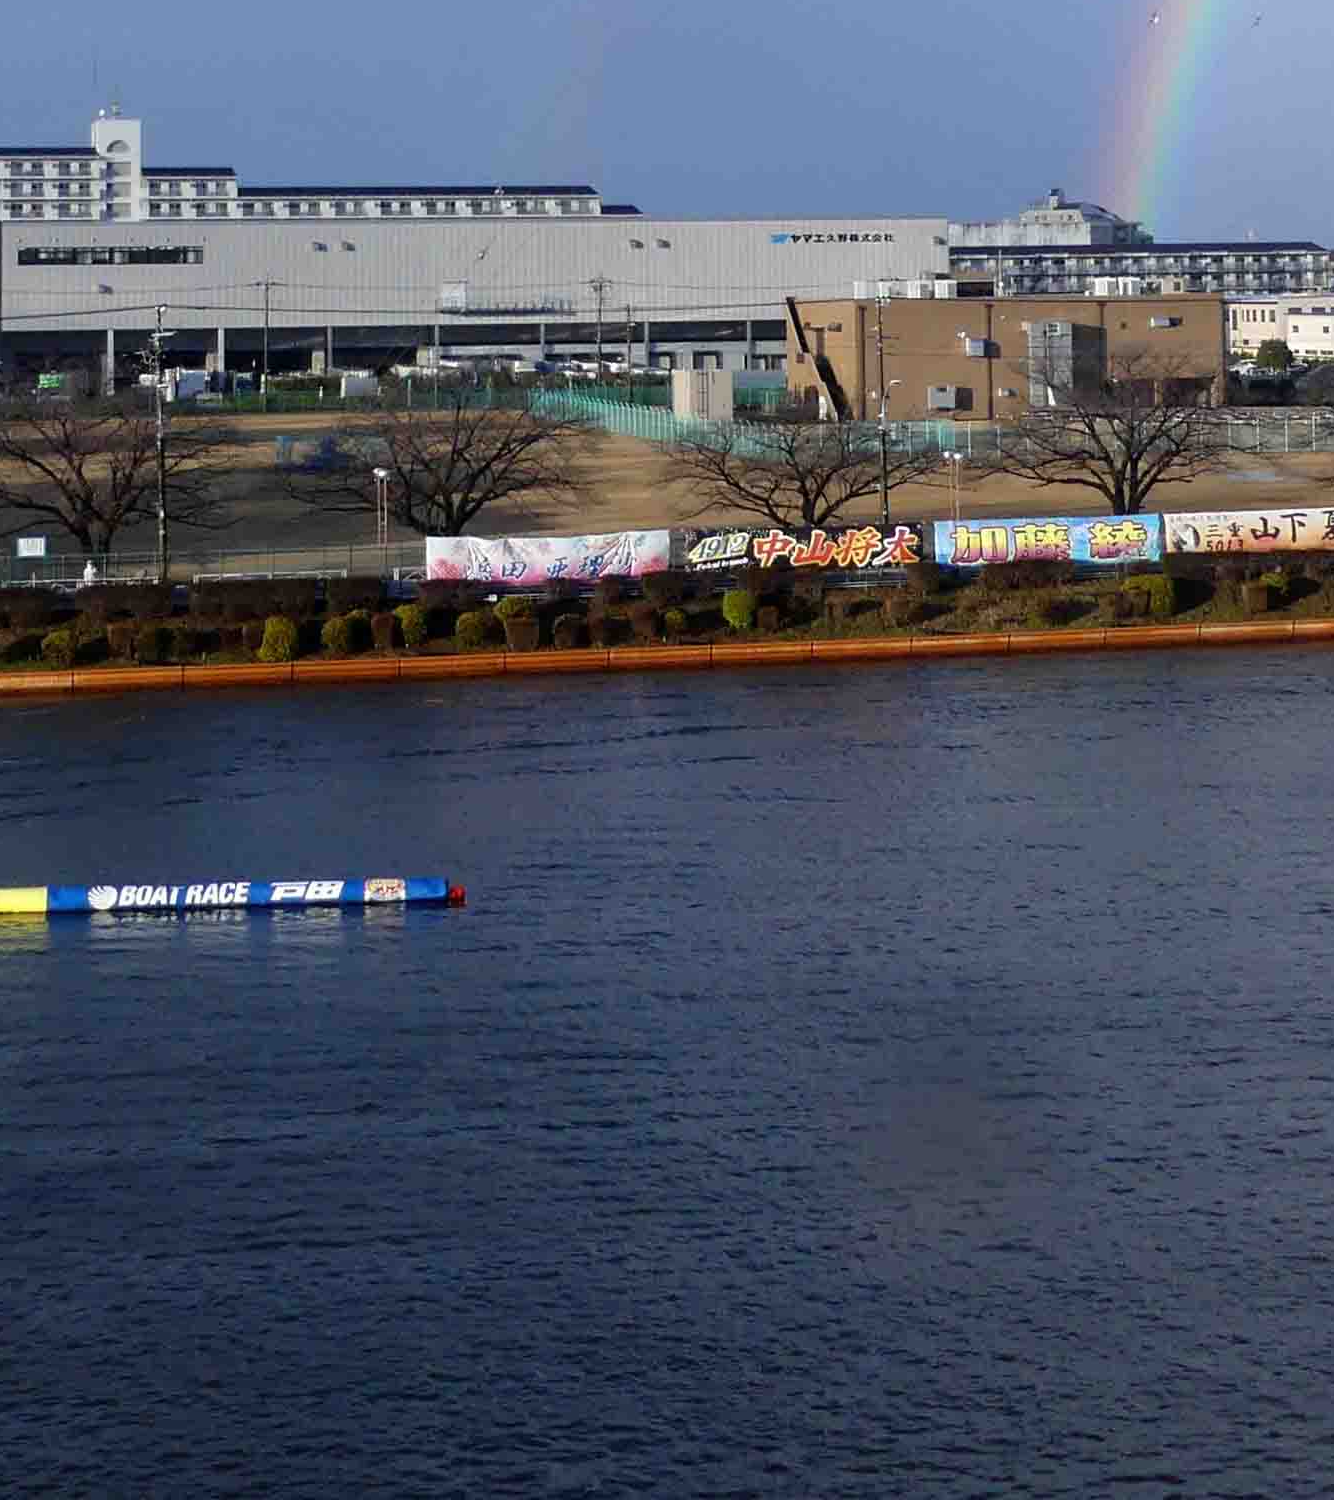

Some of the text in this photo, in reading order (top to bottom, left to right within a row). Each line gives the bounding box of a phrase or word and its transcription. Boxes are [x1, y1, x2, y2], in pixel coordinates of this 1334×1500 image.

[951, 523, 1069, 563] 加藤
[1250, 512, 1308, 543] 山下
[689, 532, 749, 562] 4912
[753, 525, 920, 568] 中山将太
[118, 884, 181, 908] BOAT
[185, 881, 252, 906] RACE
